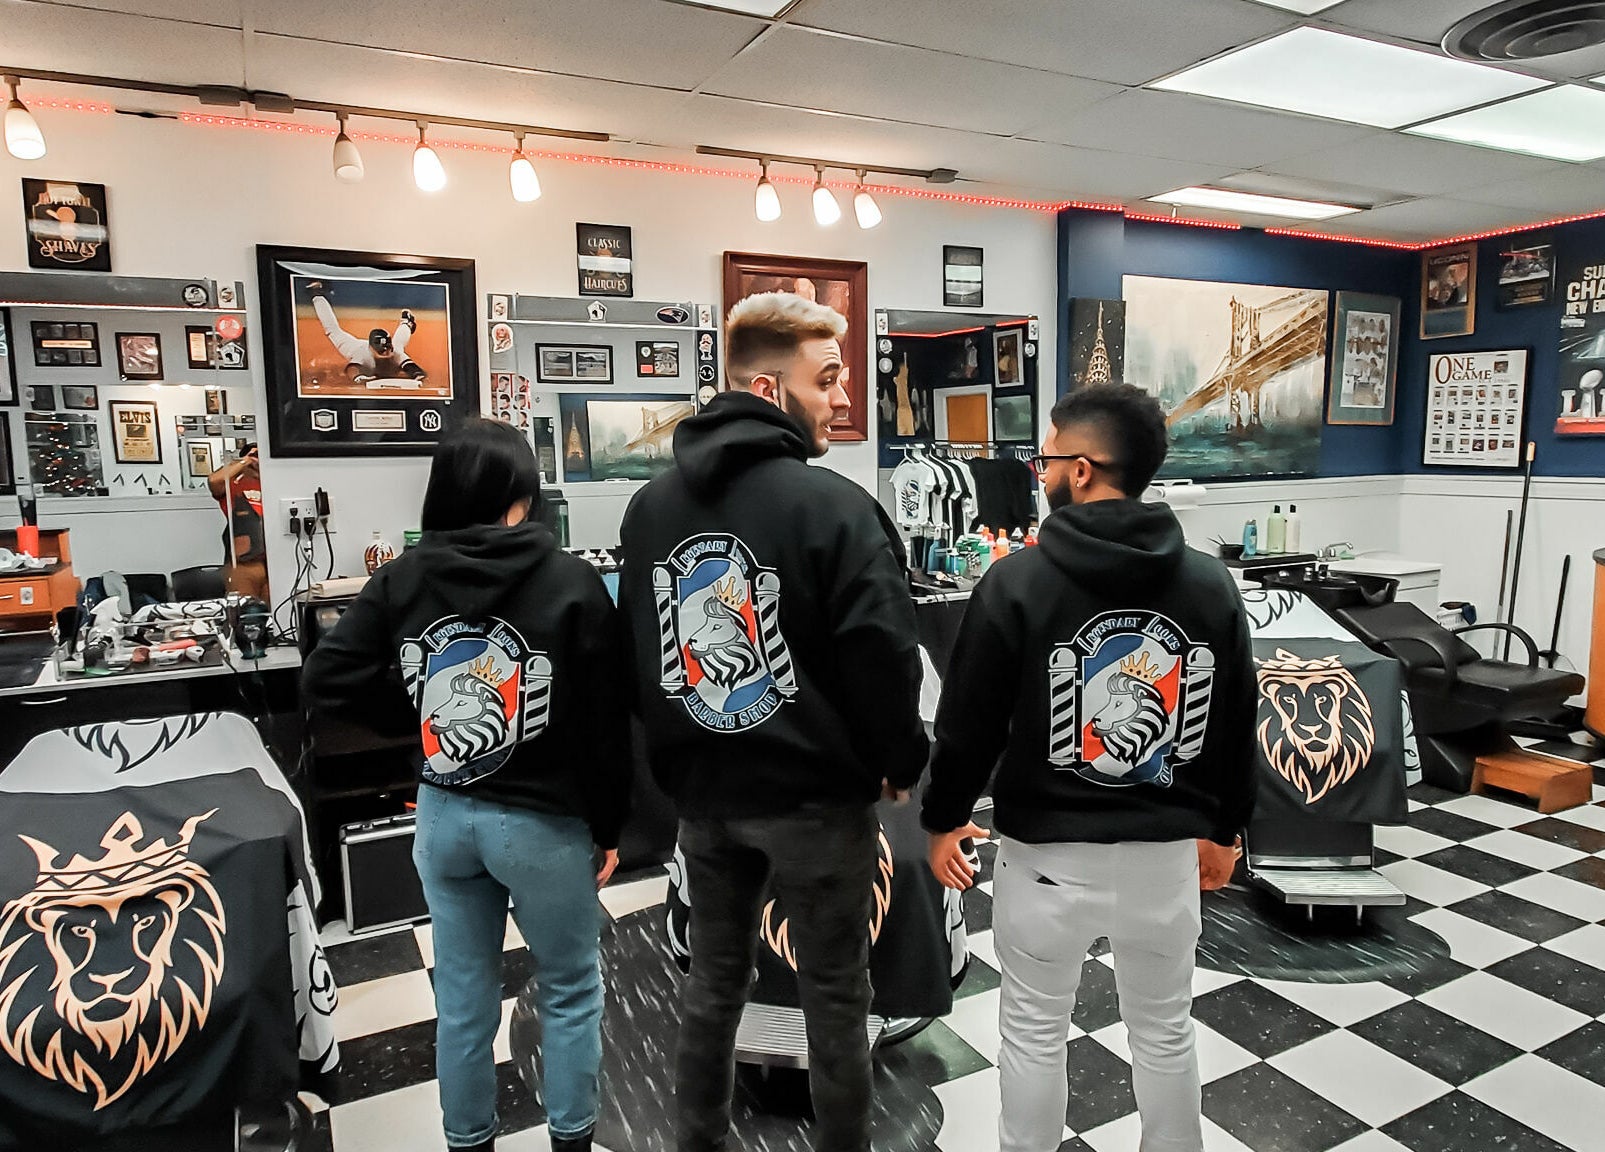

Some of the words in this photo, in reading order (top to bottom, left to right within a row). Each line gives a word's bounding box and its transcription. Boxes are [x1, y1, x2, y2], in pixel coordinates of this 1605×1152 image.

[587, 237, 621, 250] CLASSIC
[1583, 264, 1605, 281] SU
[1435, 355, 1476, 385] ONE
[1451, 369, 1493, 381] GAME
[118, 410, 152, 424] ELVIS
[686, 691, 736, 729] BARBER
[739, 692, 778, 726] SHOP
